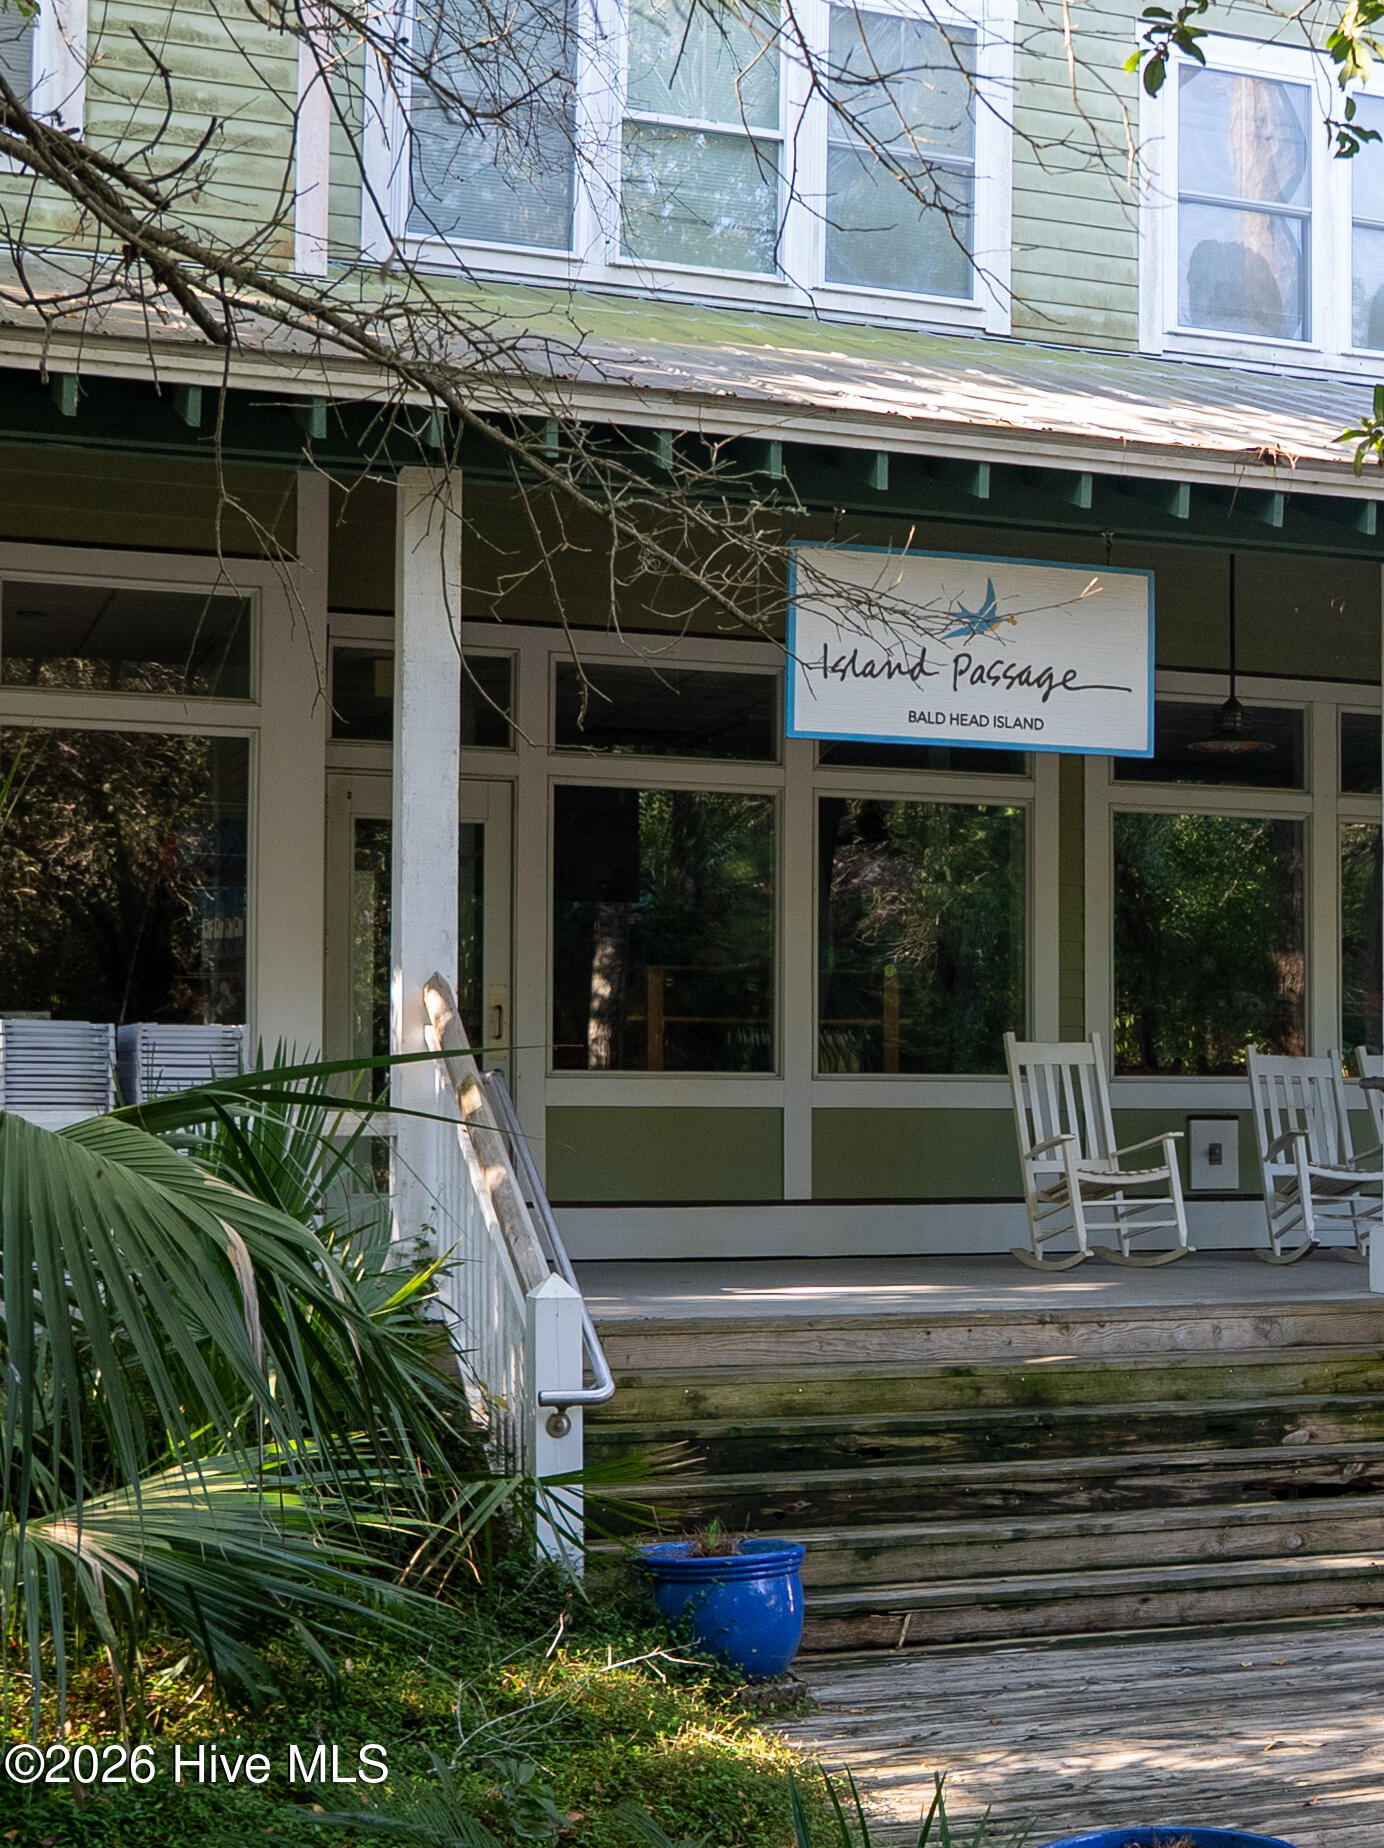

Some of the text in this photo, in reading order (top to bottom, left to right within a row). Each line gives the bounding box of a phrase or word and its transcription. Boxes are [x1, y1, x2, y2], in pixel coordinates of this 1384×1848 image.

[823, 643, 1132, 703] Island Passage
[908, 710, 1045, 732] BALD HEAD ISLAND
